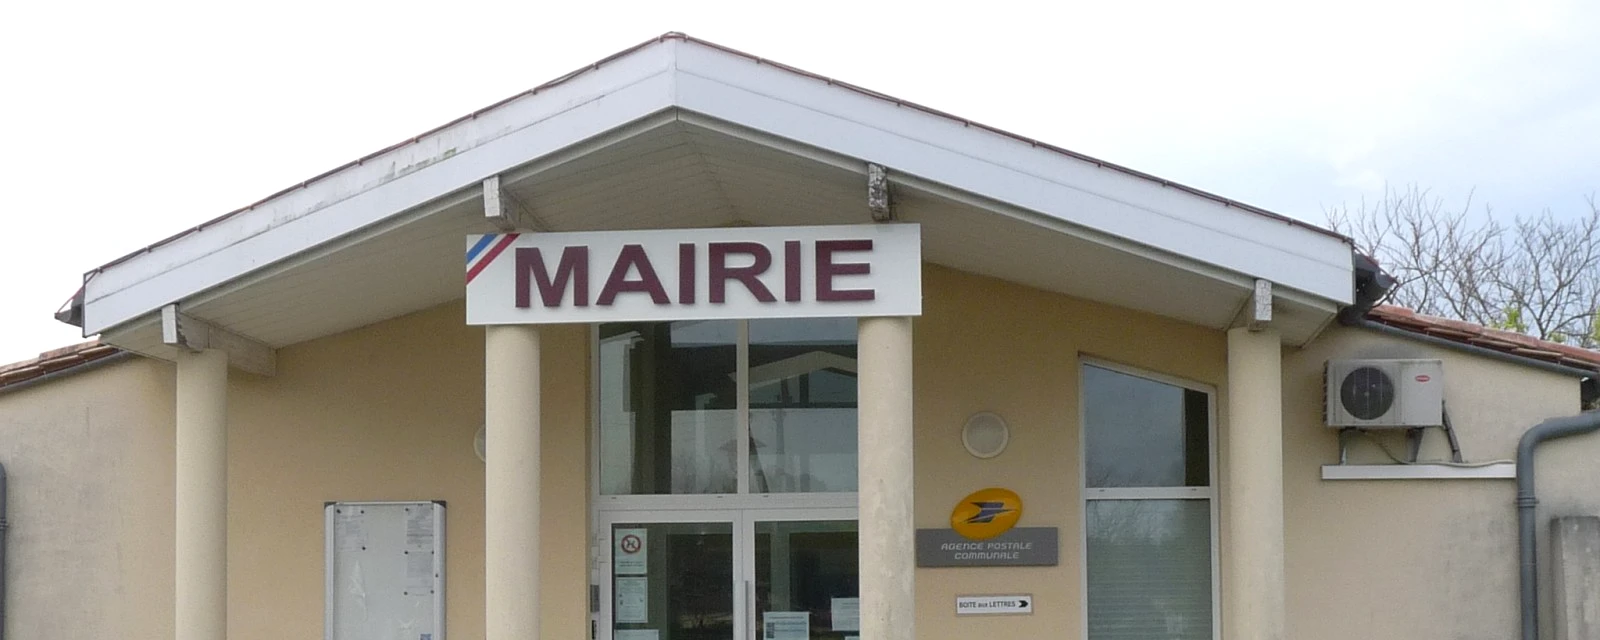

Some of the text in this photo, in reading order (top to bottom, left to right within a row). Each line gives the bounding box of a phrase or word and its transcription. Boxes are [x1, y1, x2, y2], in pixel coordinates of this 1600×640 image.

[514, 239, 876, 308] MAIRIE
[941, 541, 1033, 550] AGENCE POSTALE
[954, 551, 1020, 560] COMMUNALE
[989, 600, 1016, 608] LETTRES
